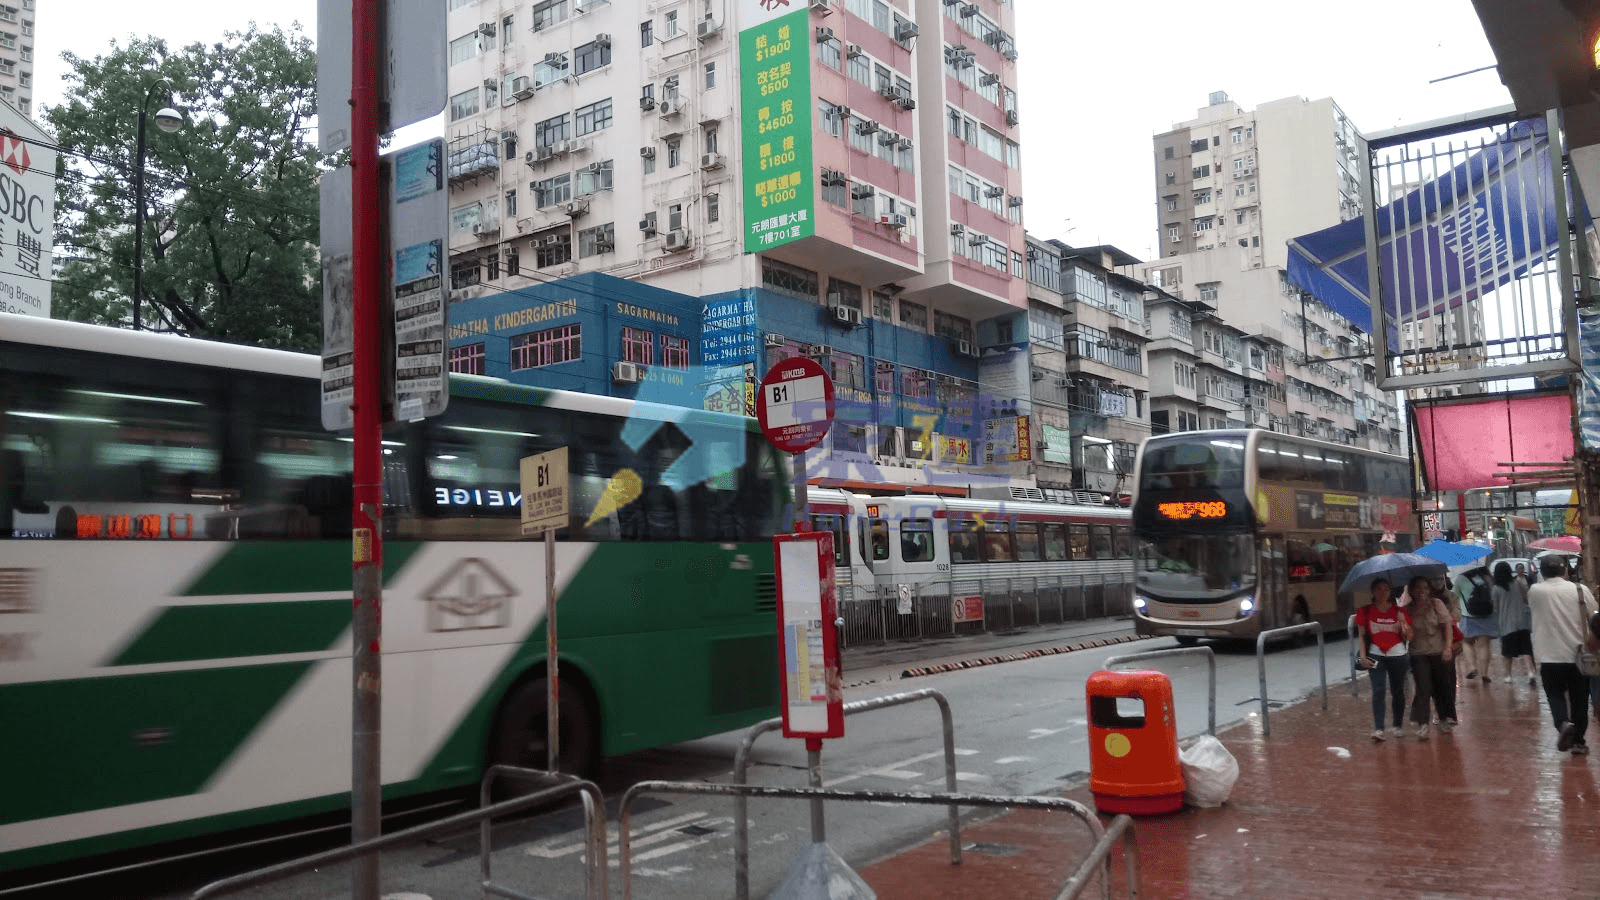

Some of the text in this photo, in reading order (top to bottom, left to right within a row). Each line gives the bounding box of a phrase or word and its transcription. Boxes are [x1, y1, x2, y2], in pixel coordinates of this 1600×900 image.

[756, 39, 791, 61] $1900
[760, 77, 789, 96] $500
[760, 151, 795, 171] $1800
[761, 188, 796, 208] $1000
[759, 225, 801, 245] 7樓701室
[16, 284, 42, 310] Branch
[402, 293, 426, 308] OUTLET
[494, 298, 577, 331] KINDERGARTEN
[617, 302, 679, 326] SAGARMATHA
[703, 300, 754, 321] SAGARMAHA
[703, 337, 718, 349] Tel:
[719, 334, 737, 346] 2944
[704, 352, 719, 362] Fax:
[721, 347, 737, 359] 2944
[773, 385, 787, 403] B1
[835, 385, 892, 409] KINDERGATEN
[537, 463, 549, 487] B1
[867, 506, 878, 517] 10
[1199, 501, 1226, 517] 968
[936, 563, 949, 571] 1028
